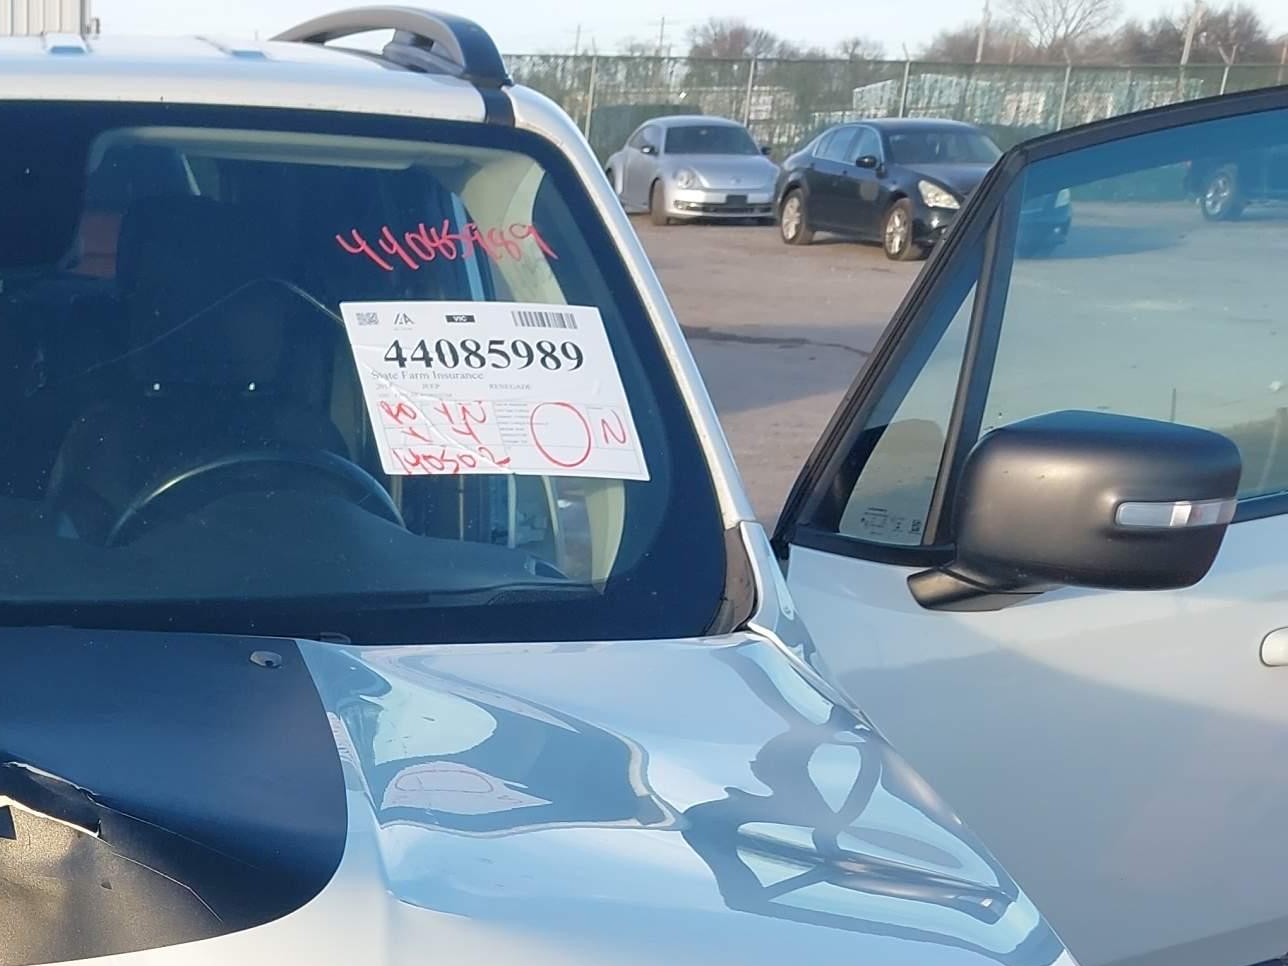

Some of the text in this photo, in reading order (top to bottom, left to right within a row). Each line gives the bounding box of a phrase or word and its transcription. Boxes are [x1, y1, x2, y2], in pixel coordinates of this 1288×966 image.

[383, 339, 584, 371] 44085989
[371, 370, 484, 380] State Farm Insurance
